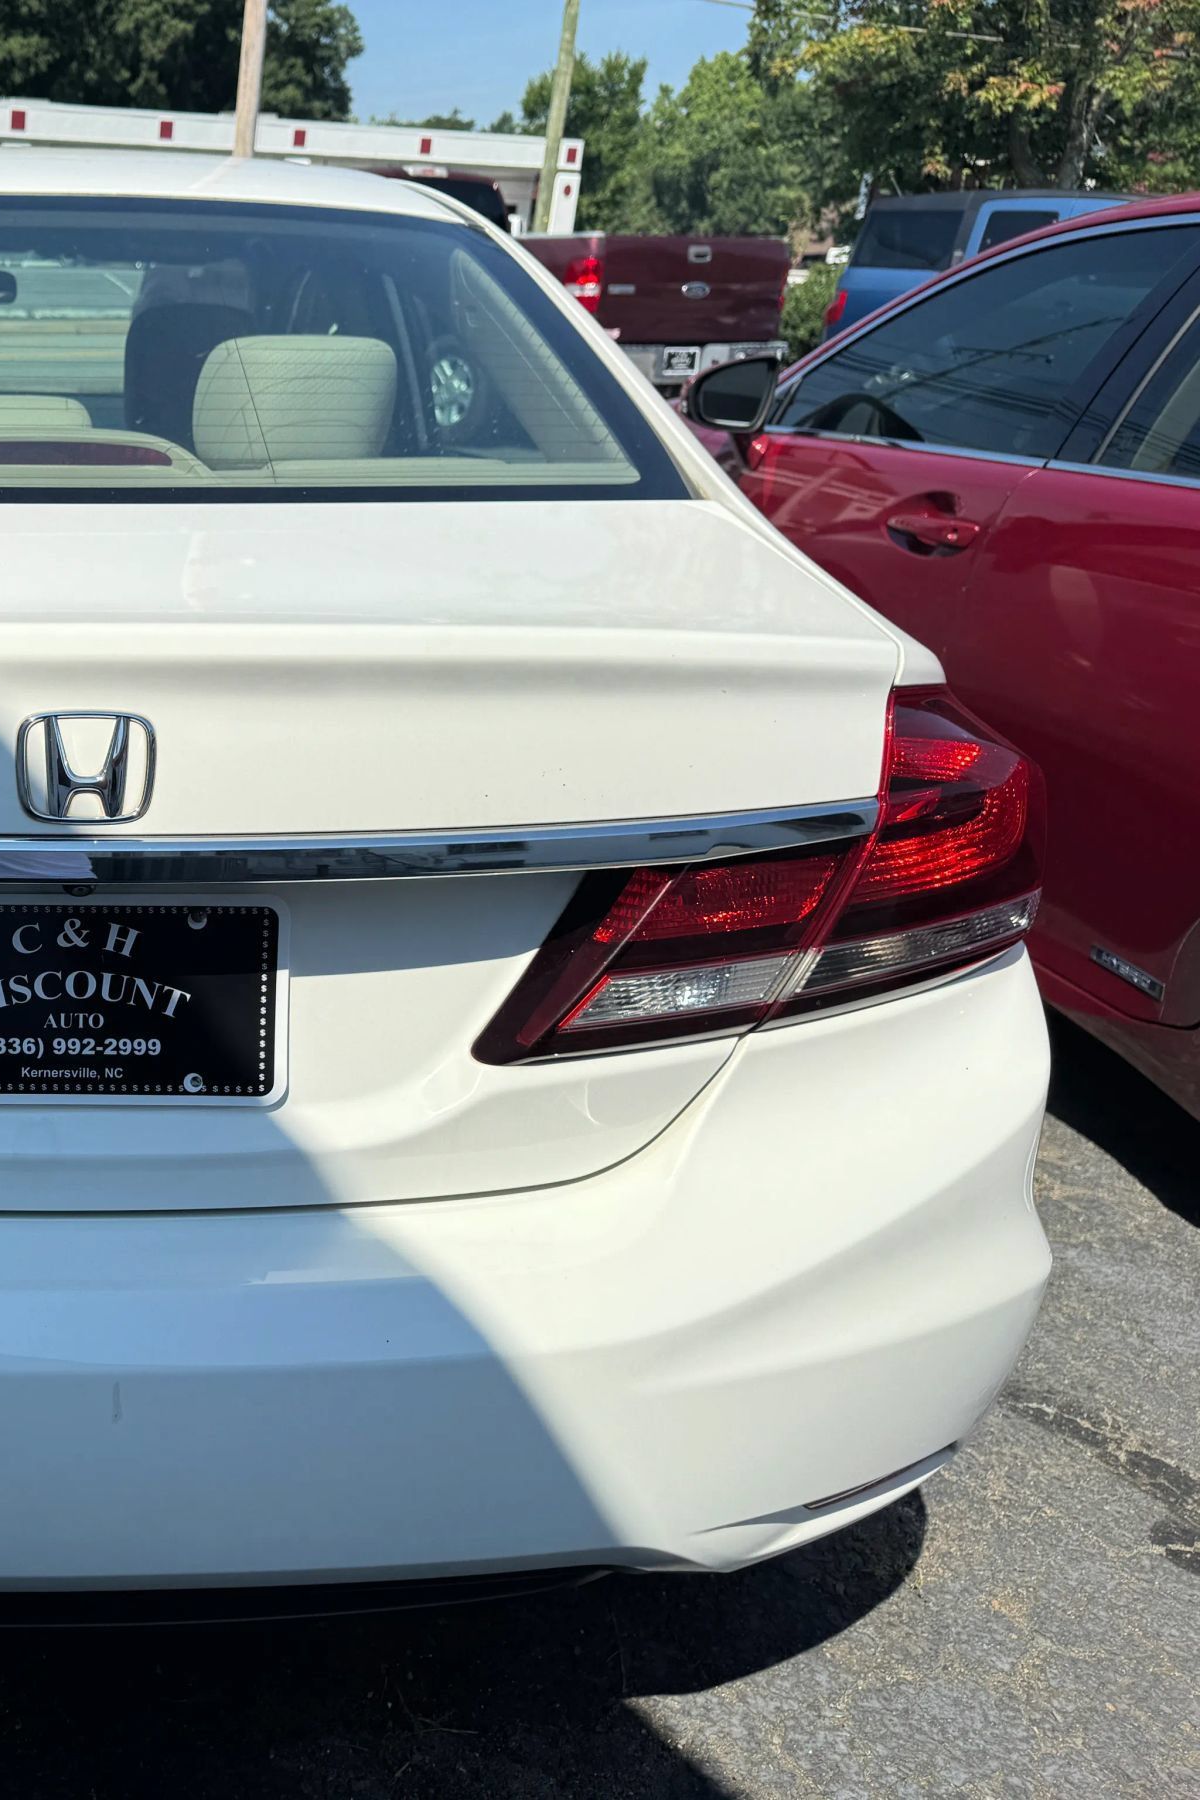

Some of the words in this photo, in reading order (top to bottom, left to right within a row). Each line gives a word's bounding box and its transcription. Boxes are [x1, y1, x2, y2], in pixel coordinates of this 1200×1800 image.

[12, 922, 43, 954] C
[56, 918, 90, 948] &
[102, 922, 142, 958] H
[43, 1012, 105, 1030] AUTO
[52, 1038, 162, 1056] 992-2999
[20, 1066, 100, 1081] Kernersville,
[104, 1067, 124, 1080] NC
